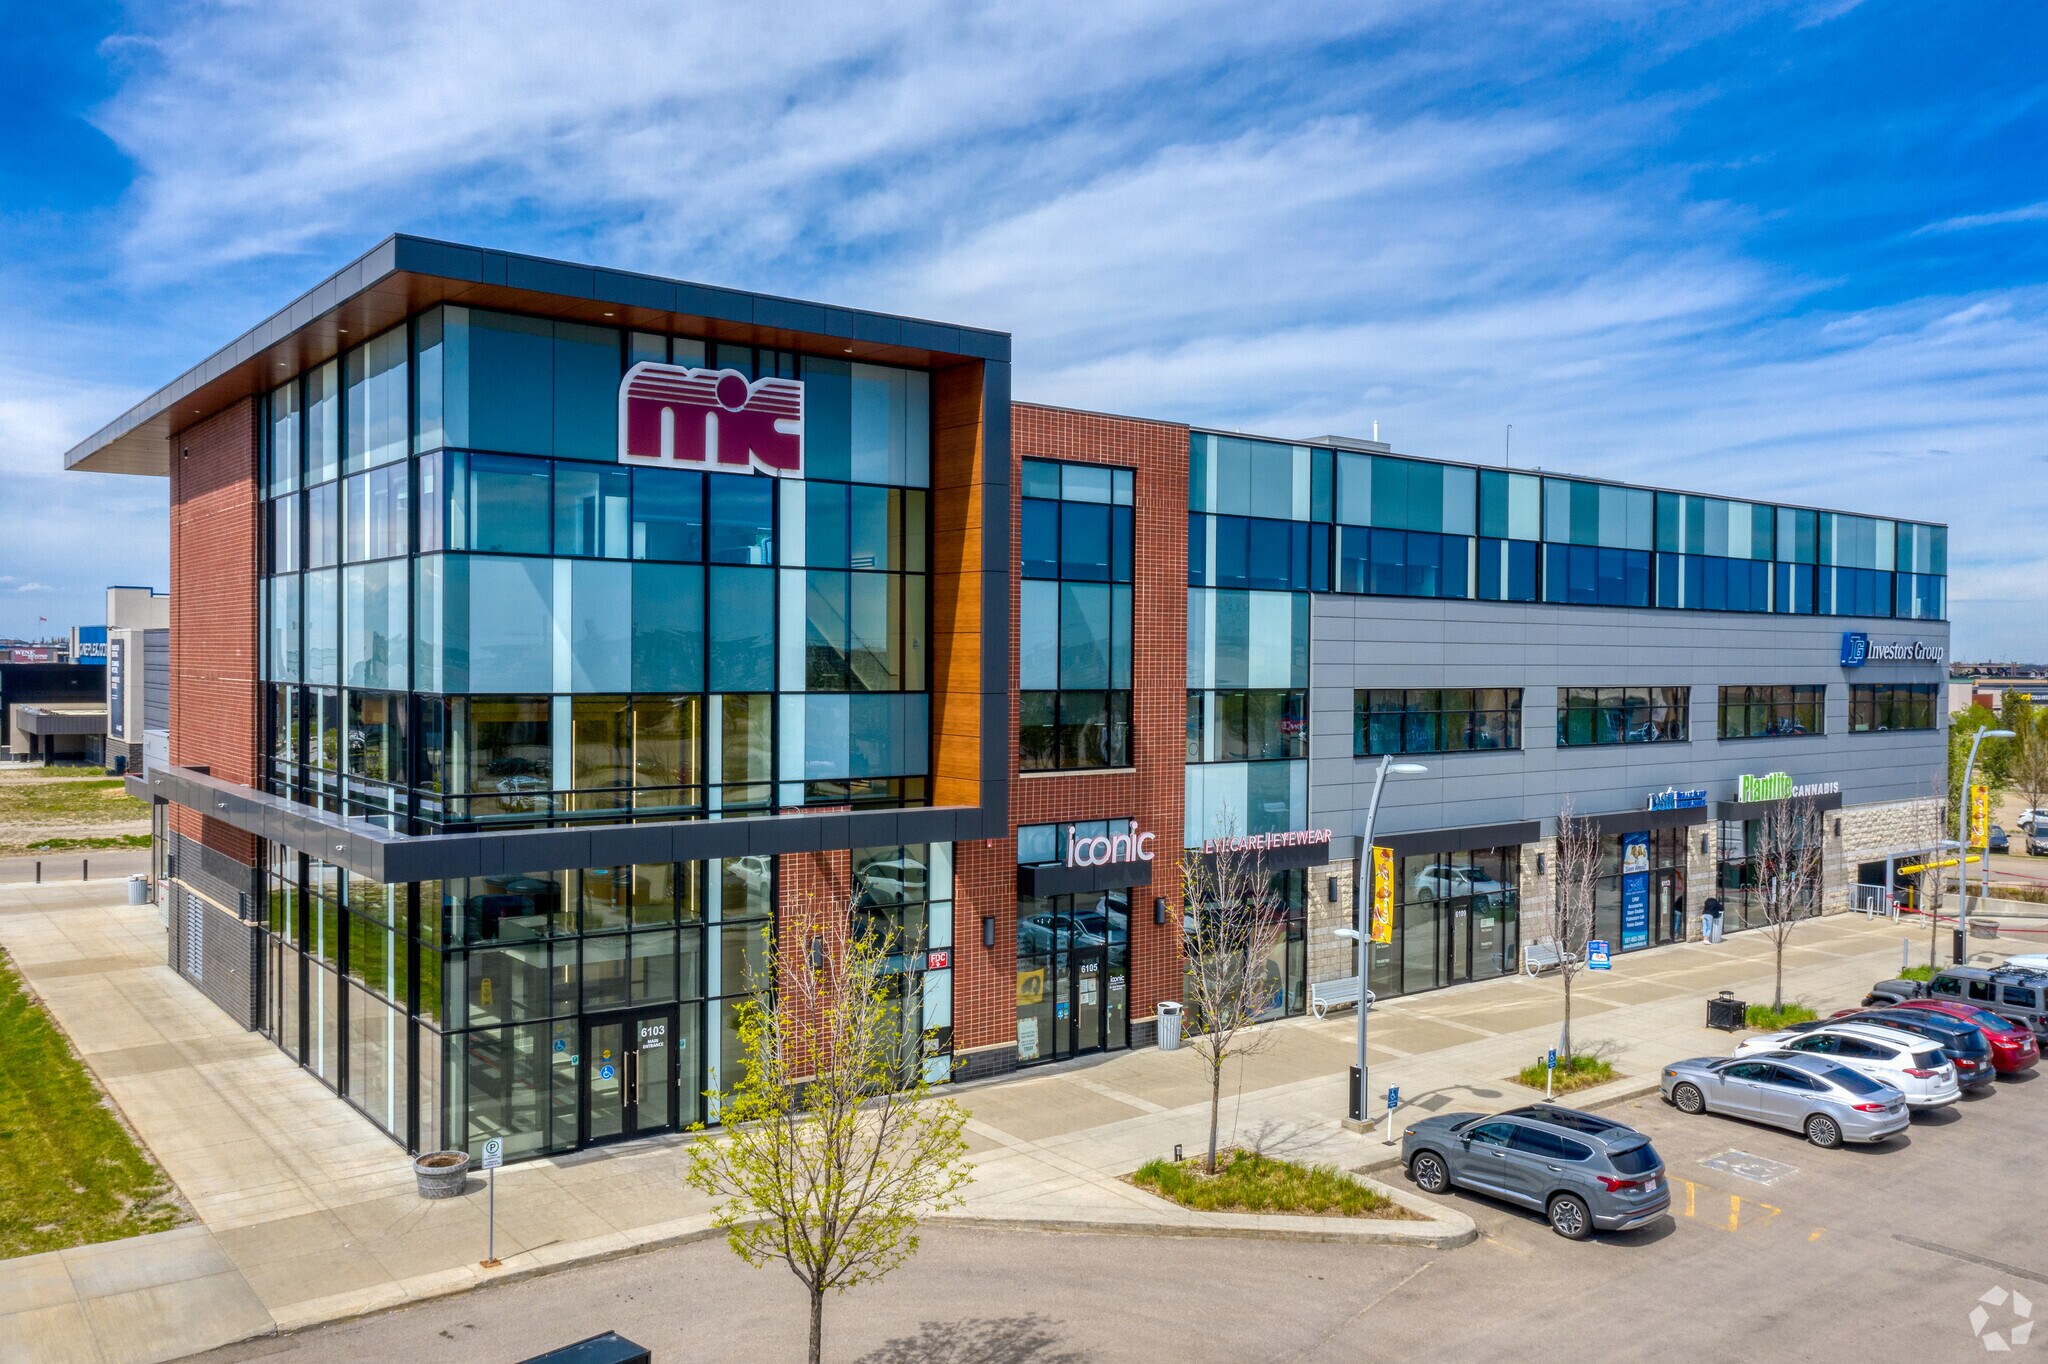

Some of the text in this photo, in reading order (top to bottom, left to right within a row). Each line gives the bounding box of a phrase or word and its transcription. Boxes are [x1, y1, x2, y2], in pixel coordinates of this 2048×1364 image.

[1867, 640, 1913, 660] Investors
[1914, 641, 1943, 664] Group
[1739, 772, 1839, 803] Plantlife CANNABIS
[1066, 820, 1156, 868] iconic
[931, 953, 946, 962] FDC
[1081, 963, 1098, 973] 6105
[641, 1025, 665, 1037] 6103
